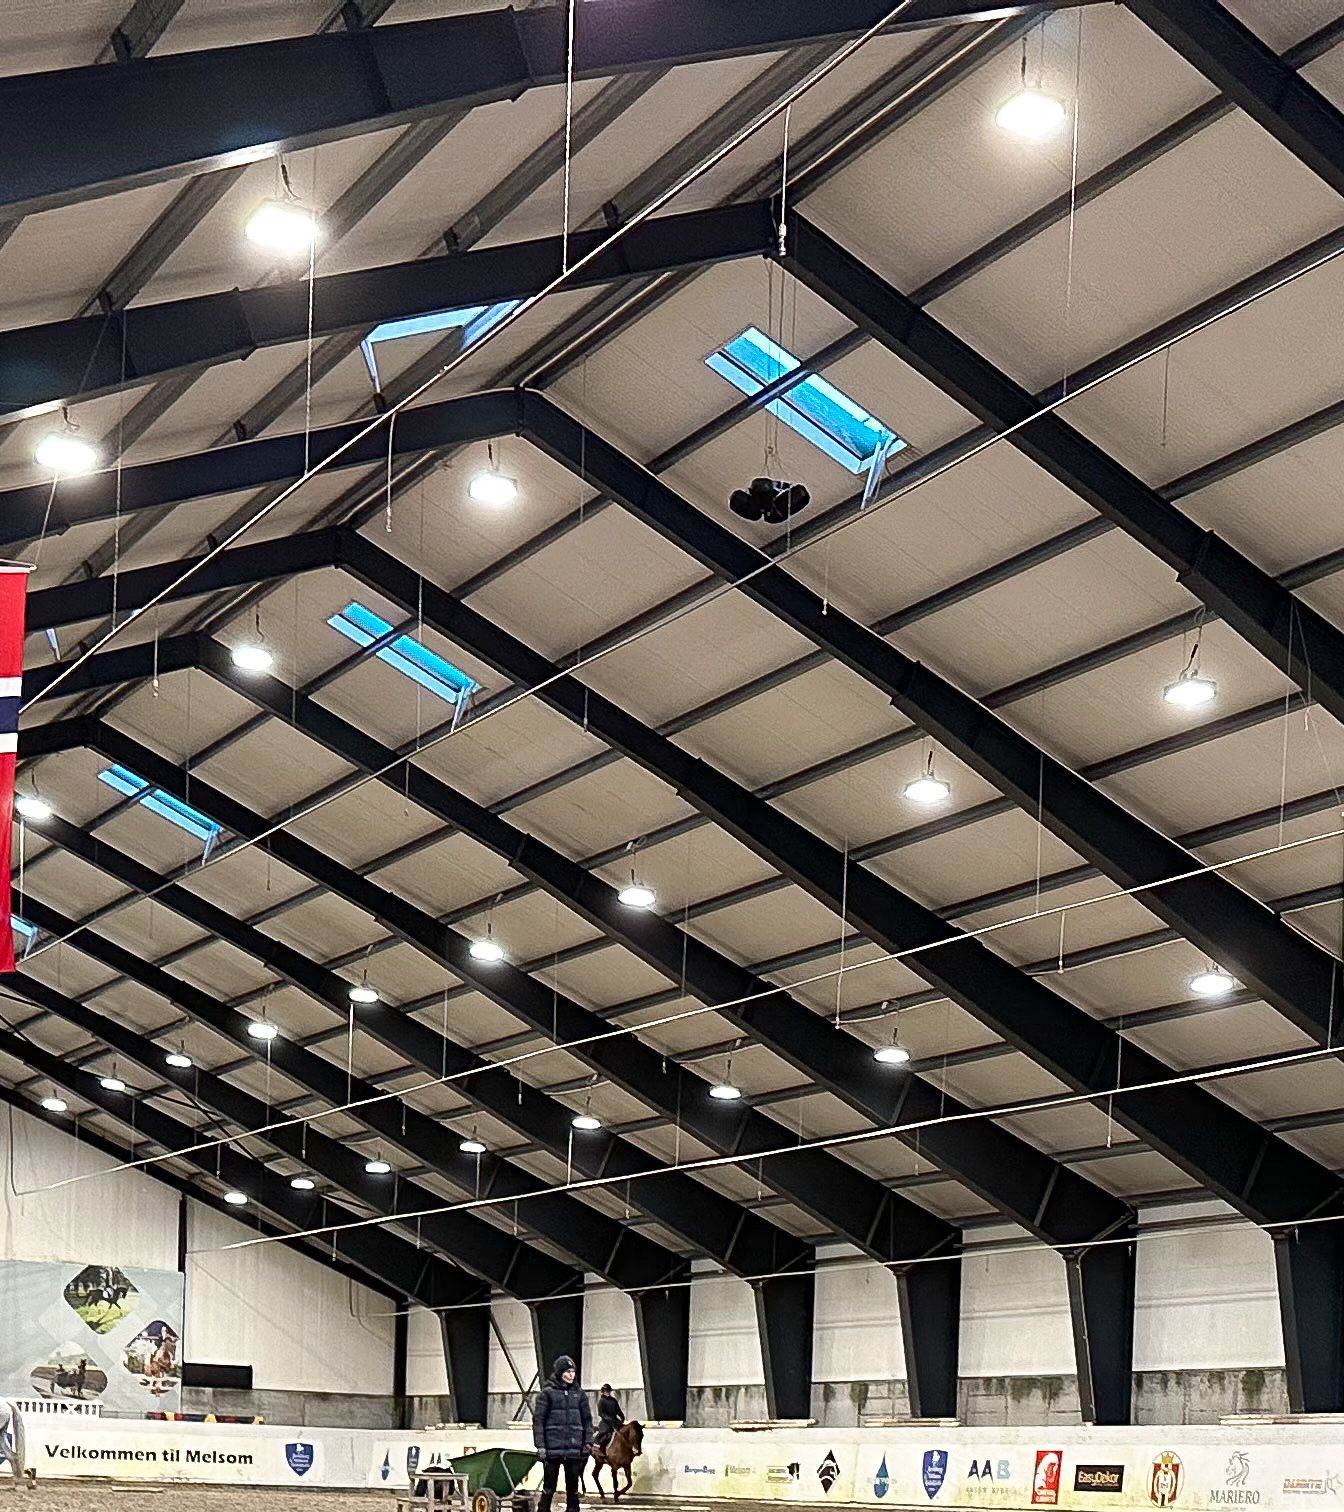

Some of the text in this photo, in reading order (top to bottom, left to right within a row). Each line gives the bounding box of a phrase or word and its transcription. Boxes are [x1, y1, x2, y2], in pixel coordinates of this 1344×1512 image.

[45, 1444, 253, 1465] Velkommen til Melsom
[967, 1459, 1010, 1483] AAB
[1210, 1489, 1260, 1505] MARIERO
